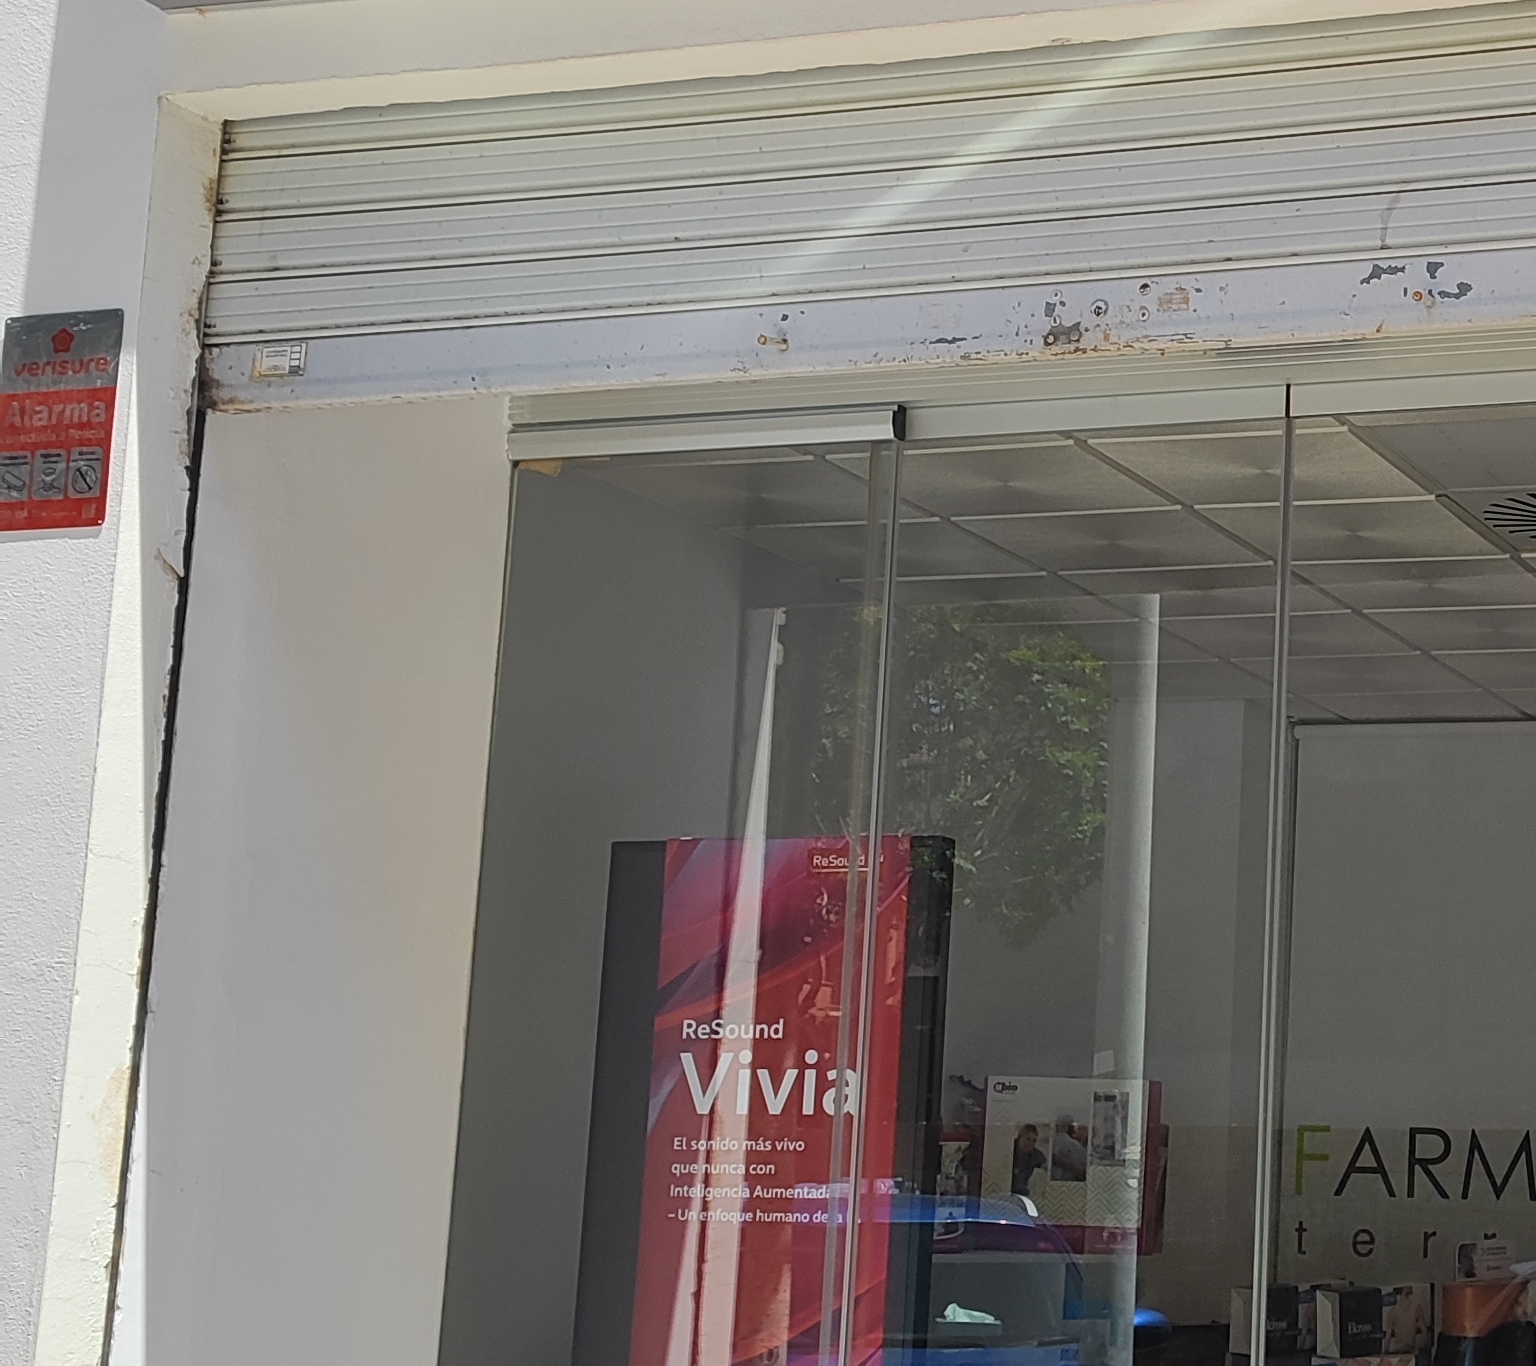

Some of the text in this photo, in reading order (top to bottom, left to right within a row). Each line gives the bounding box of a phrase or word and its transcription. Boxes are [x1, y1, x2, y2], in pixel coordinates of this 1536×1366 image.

[13, 356, 109, 378] verisure
[5, 399, 107, 427] Alarma
[812, 853, 866, 867] ReSoud
[681, 1018, 785, 1040] ReSound
[679, 1049, 860, 1116] Vivia
[673, 1136, 806, 1152] El sonido más vivo
[671, 1163, 776, 1175] que nunca con
[669, 1184, 751, 1201] Inteligencia
[677, 1208, 697, 1222] Un
[699, 1208, 754, 1225] enfoque
[755, 1208, 810, 1223] humano
[812, 1209, 829, 1223] de
